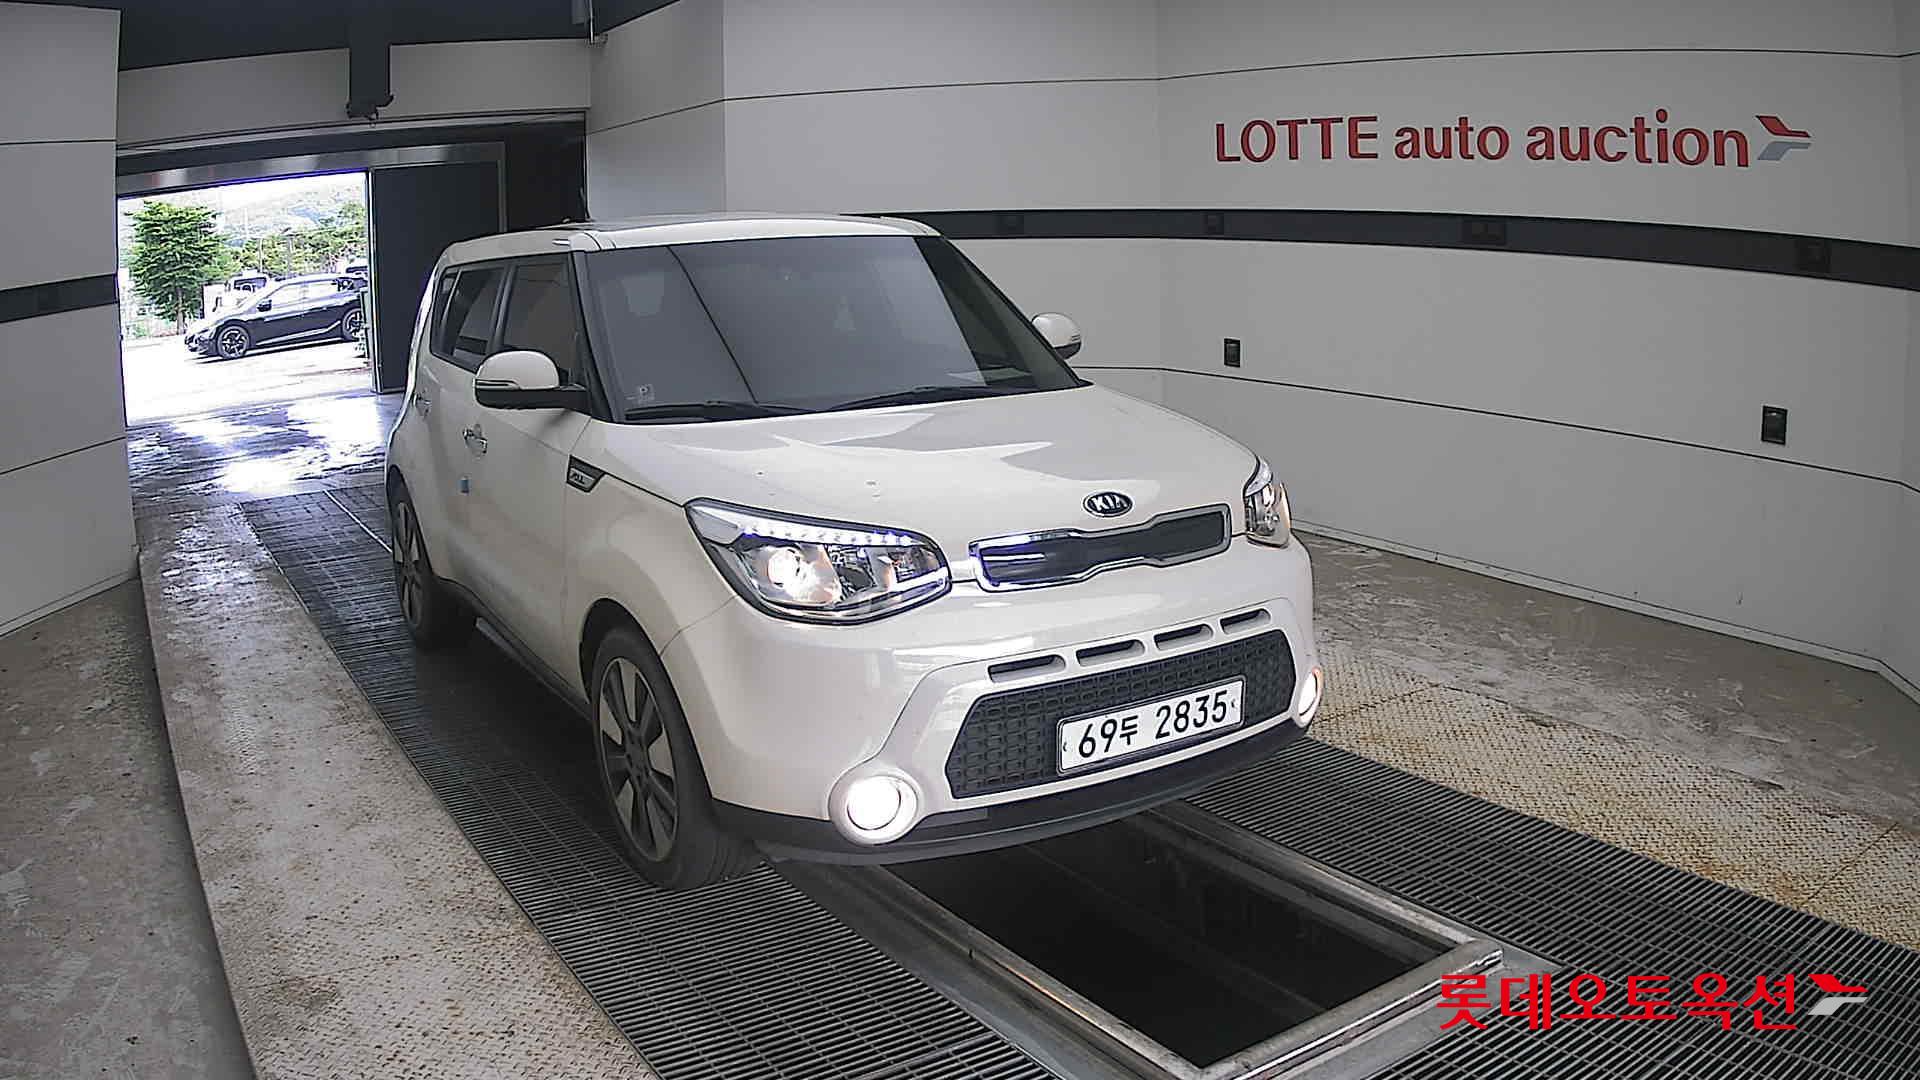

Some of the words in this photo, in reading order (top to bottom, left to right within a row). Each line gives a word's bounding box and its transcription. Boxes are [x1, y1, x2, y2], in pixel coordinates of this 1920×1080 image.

[1215, 116, 1379, 163] LOTTE
[1394, 116, 1510, 161] auto
[1525, 109, 1750, 168] auction
[1091, 494, 1128, 511] KIA
[1078, 715, 1139, 758] 69두
[1155, 690, 1228, 739] 2835
